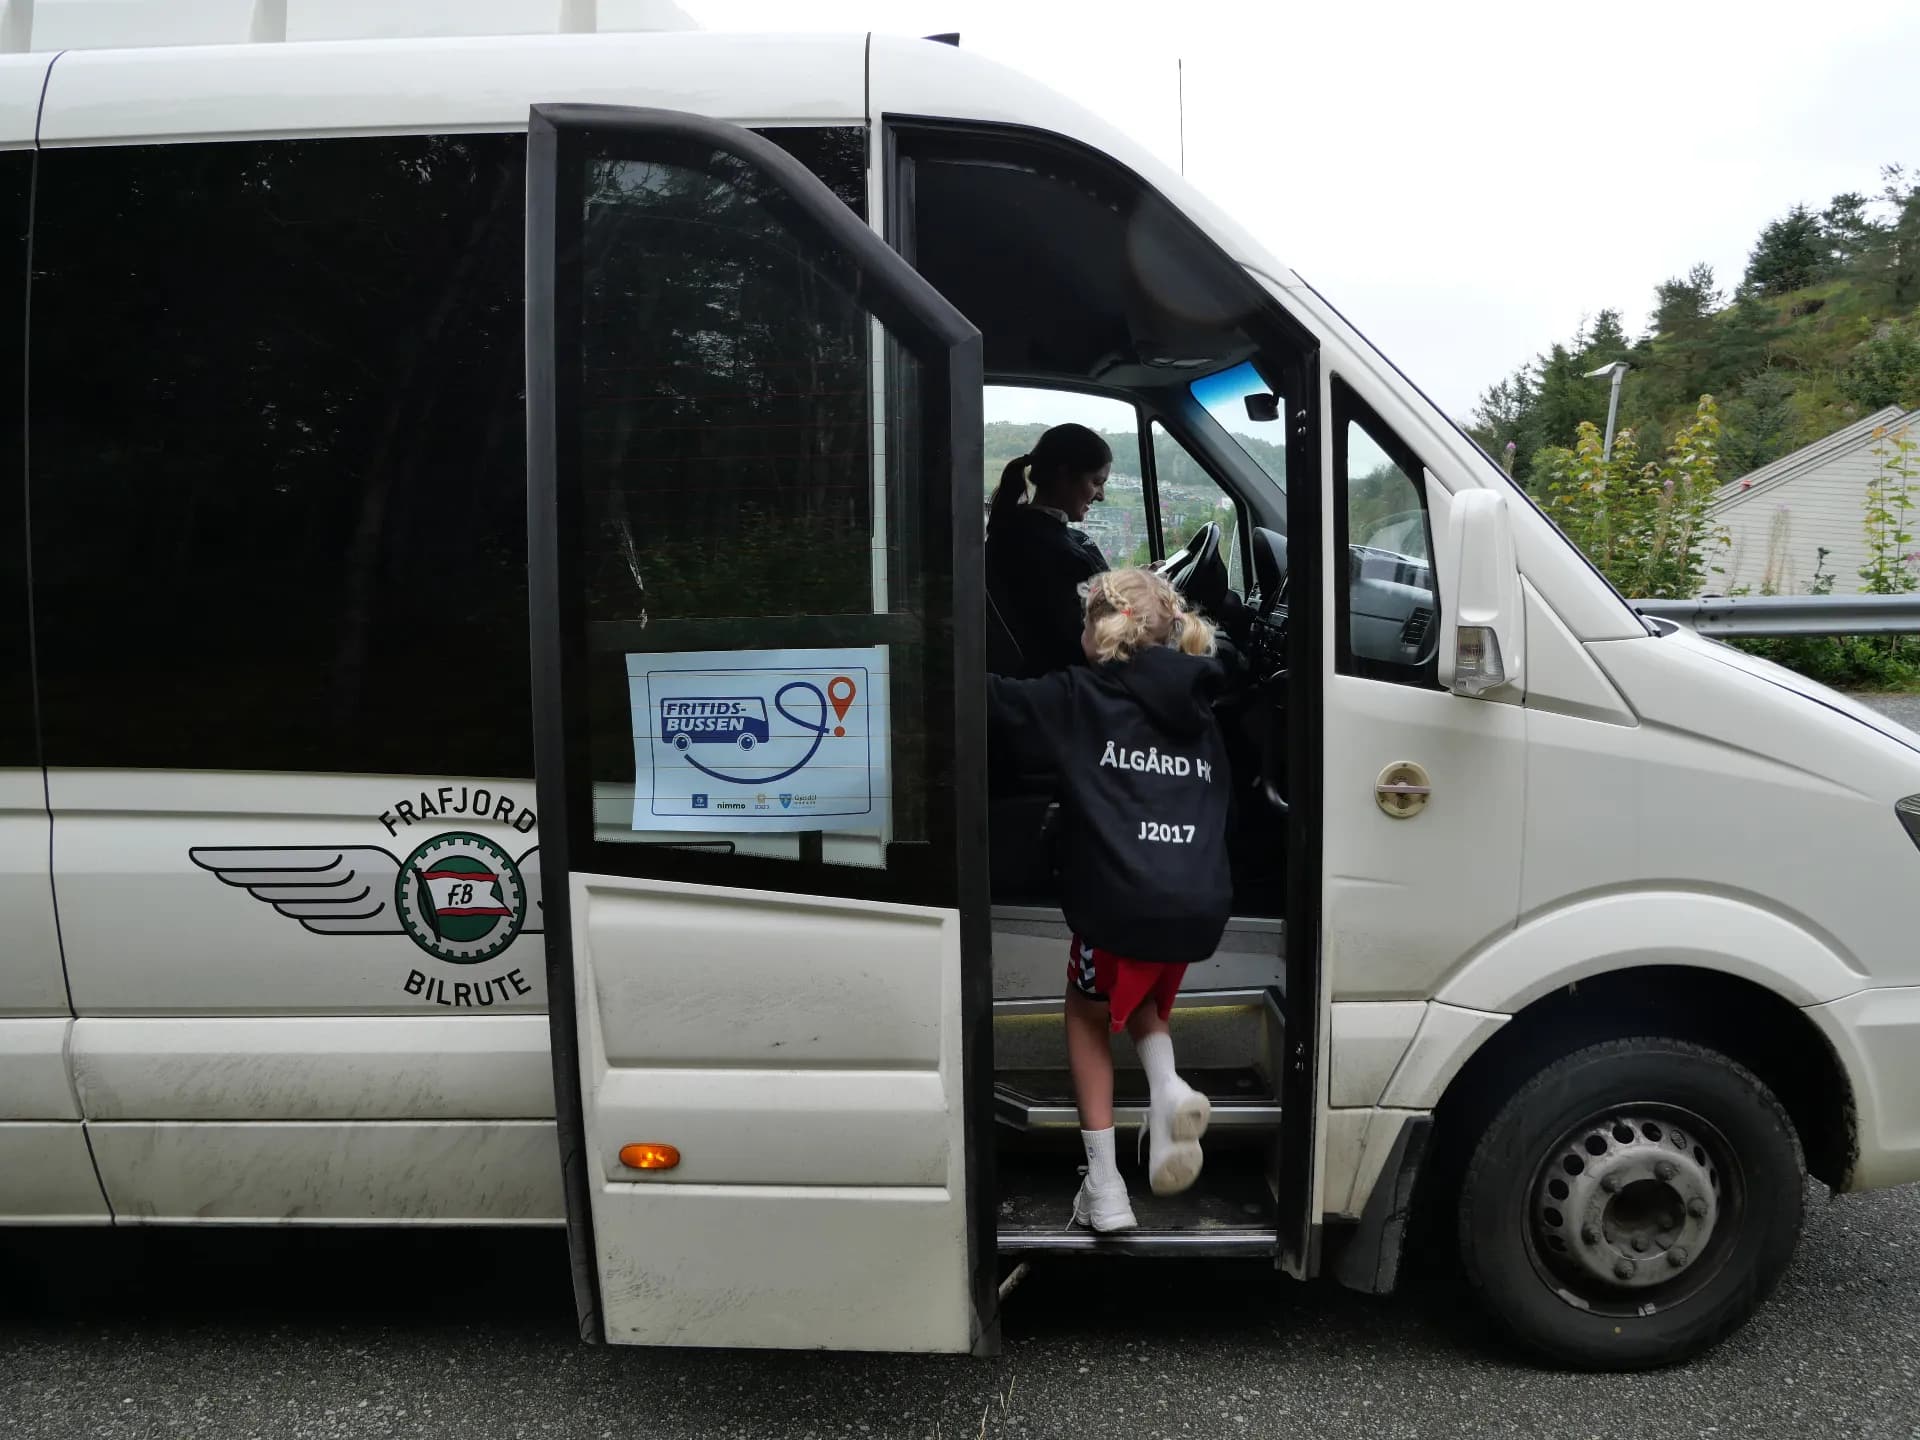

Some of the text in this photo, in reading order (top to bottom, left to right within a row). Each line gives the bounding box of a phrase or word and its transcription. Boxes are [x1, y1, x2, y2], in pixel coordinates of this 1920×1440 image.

[666, 702, 746, 715] FRITIDS-
[666, 717, 744, 731] BUSSEN
[1100, 741, 1190, 776] ÅLGÅRD
[378, 787, 536, 837] FRAFJORD
[1138, 821, 1195, 843] J2017
[404, 969, 531, 1007] BILRUTE
